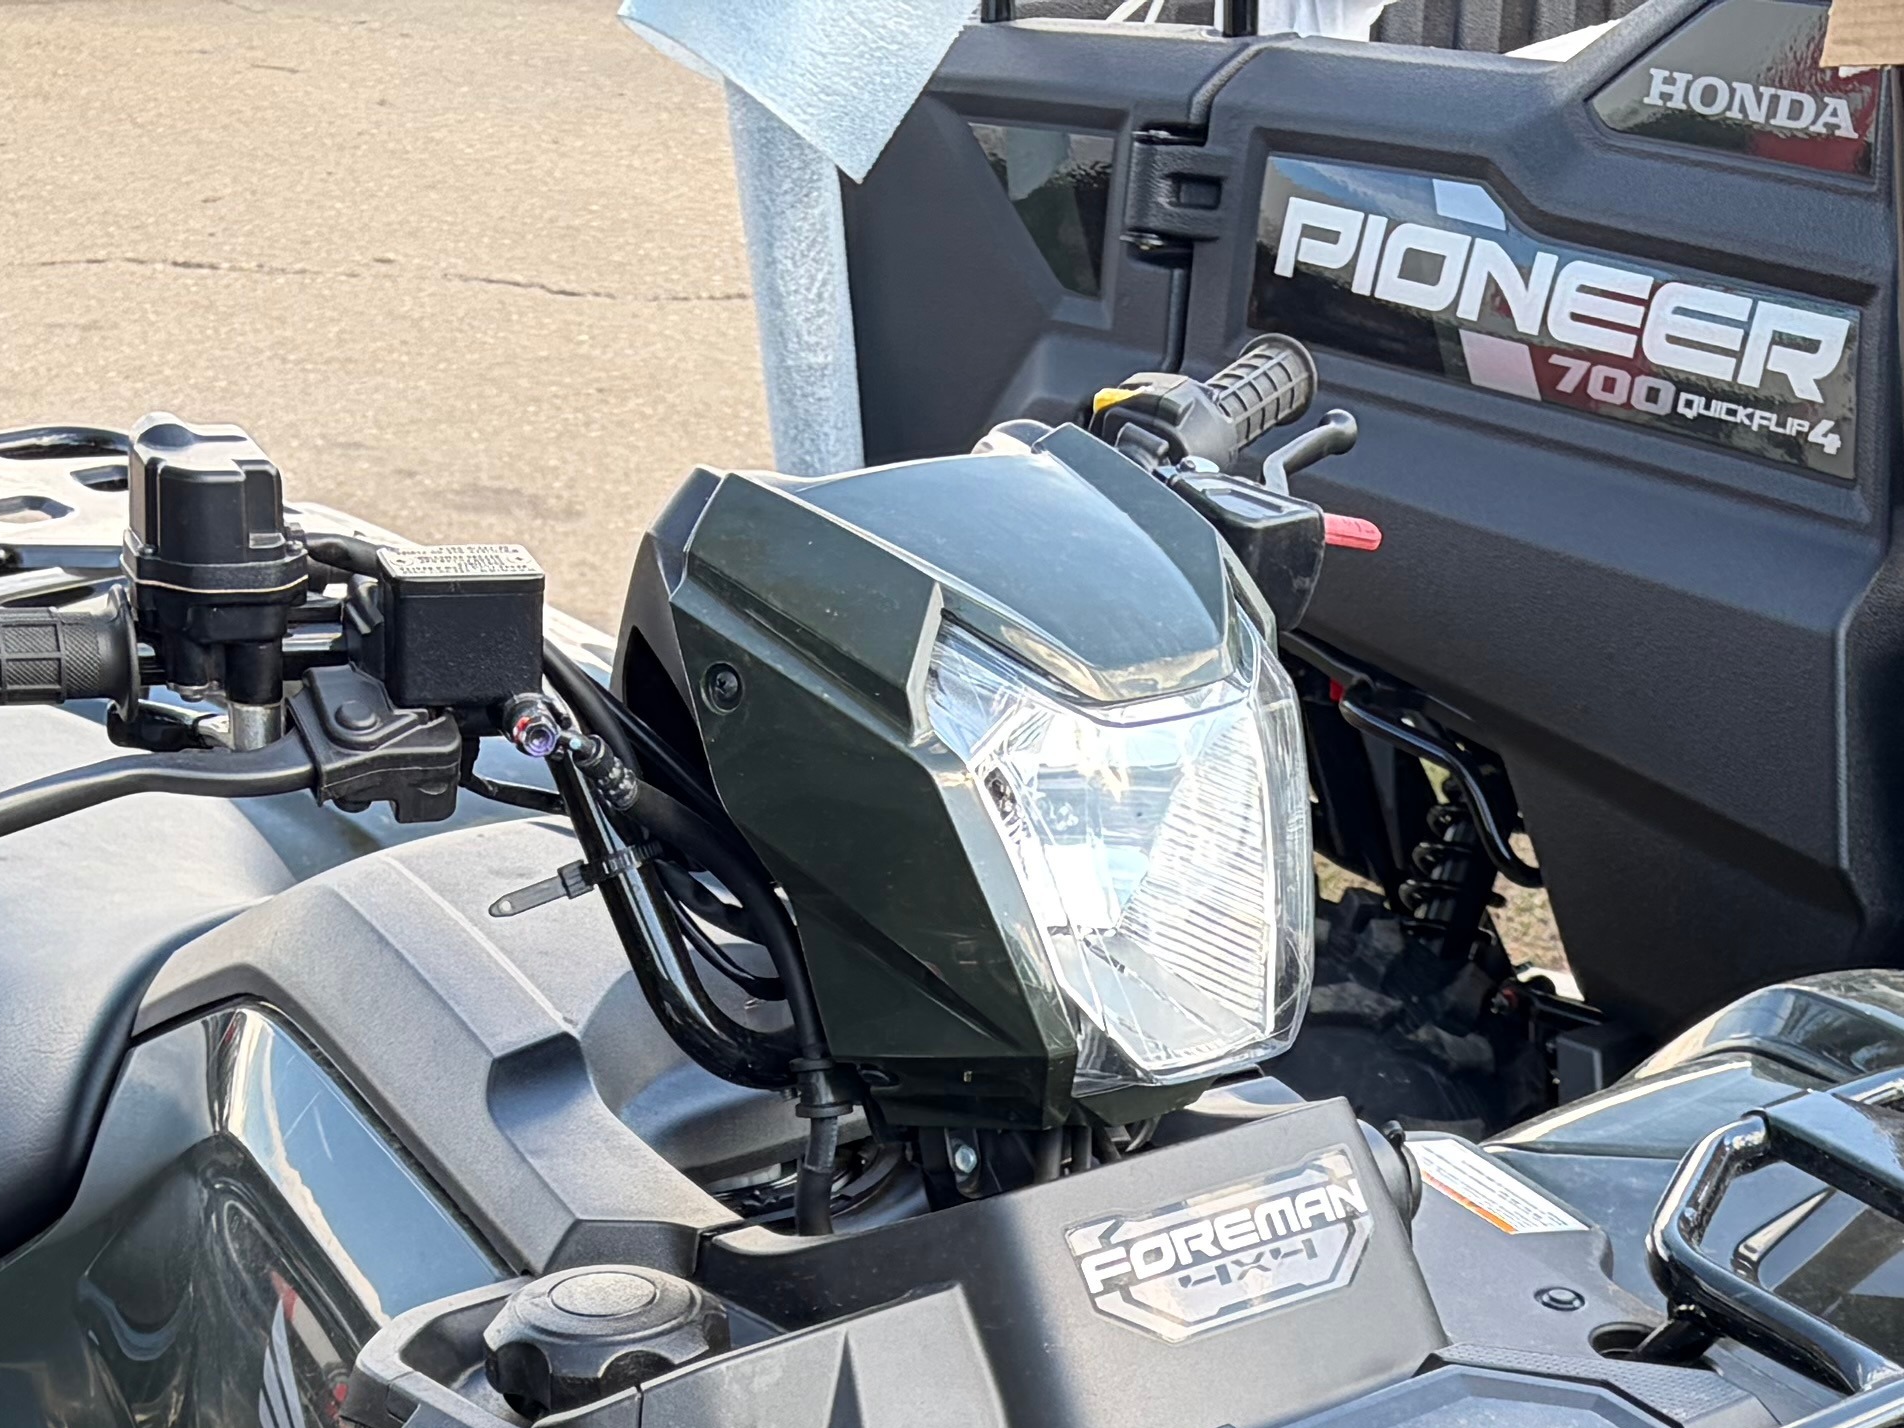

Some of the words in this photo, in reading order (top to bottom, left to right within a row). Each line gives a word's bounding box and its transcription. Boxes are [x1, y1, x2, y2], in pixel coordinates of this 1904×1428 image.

[1642, 67, 1859, 140] HONDA
[1274, 196, 1851, 404] PIONEER
[1548, 353, 1676, 416] 700
[1080, 1178, 1367, 1295] FOREMAN
